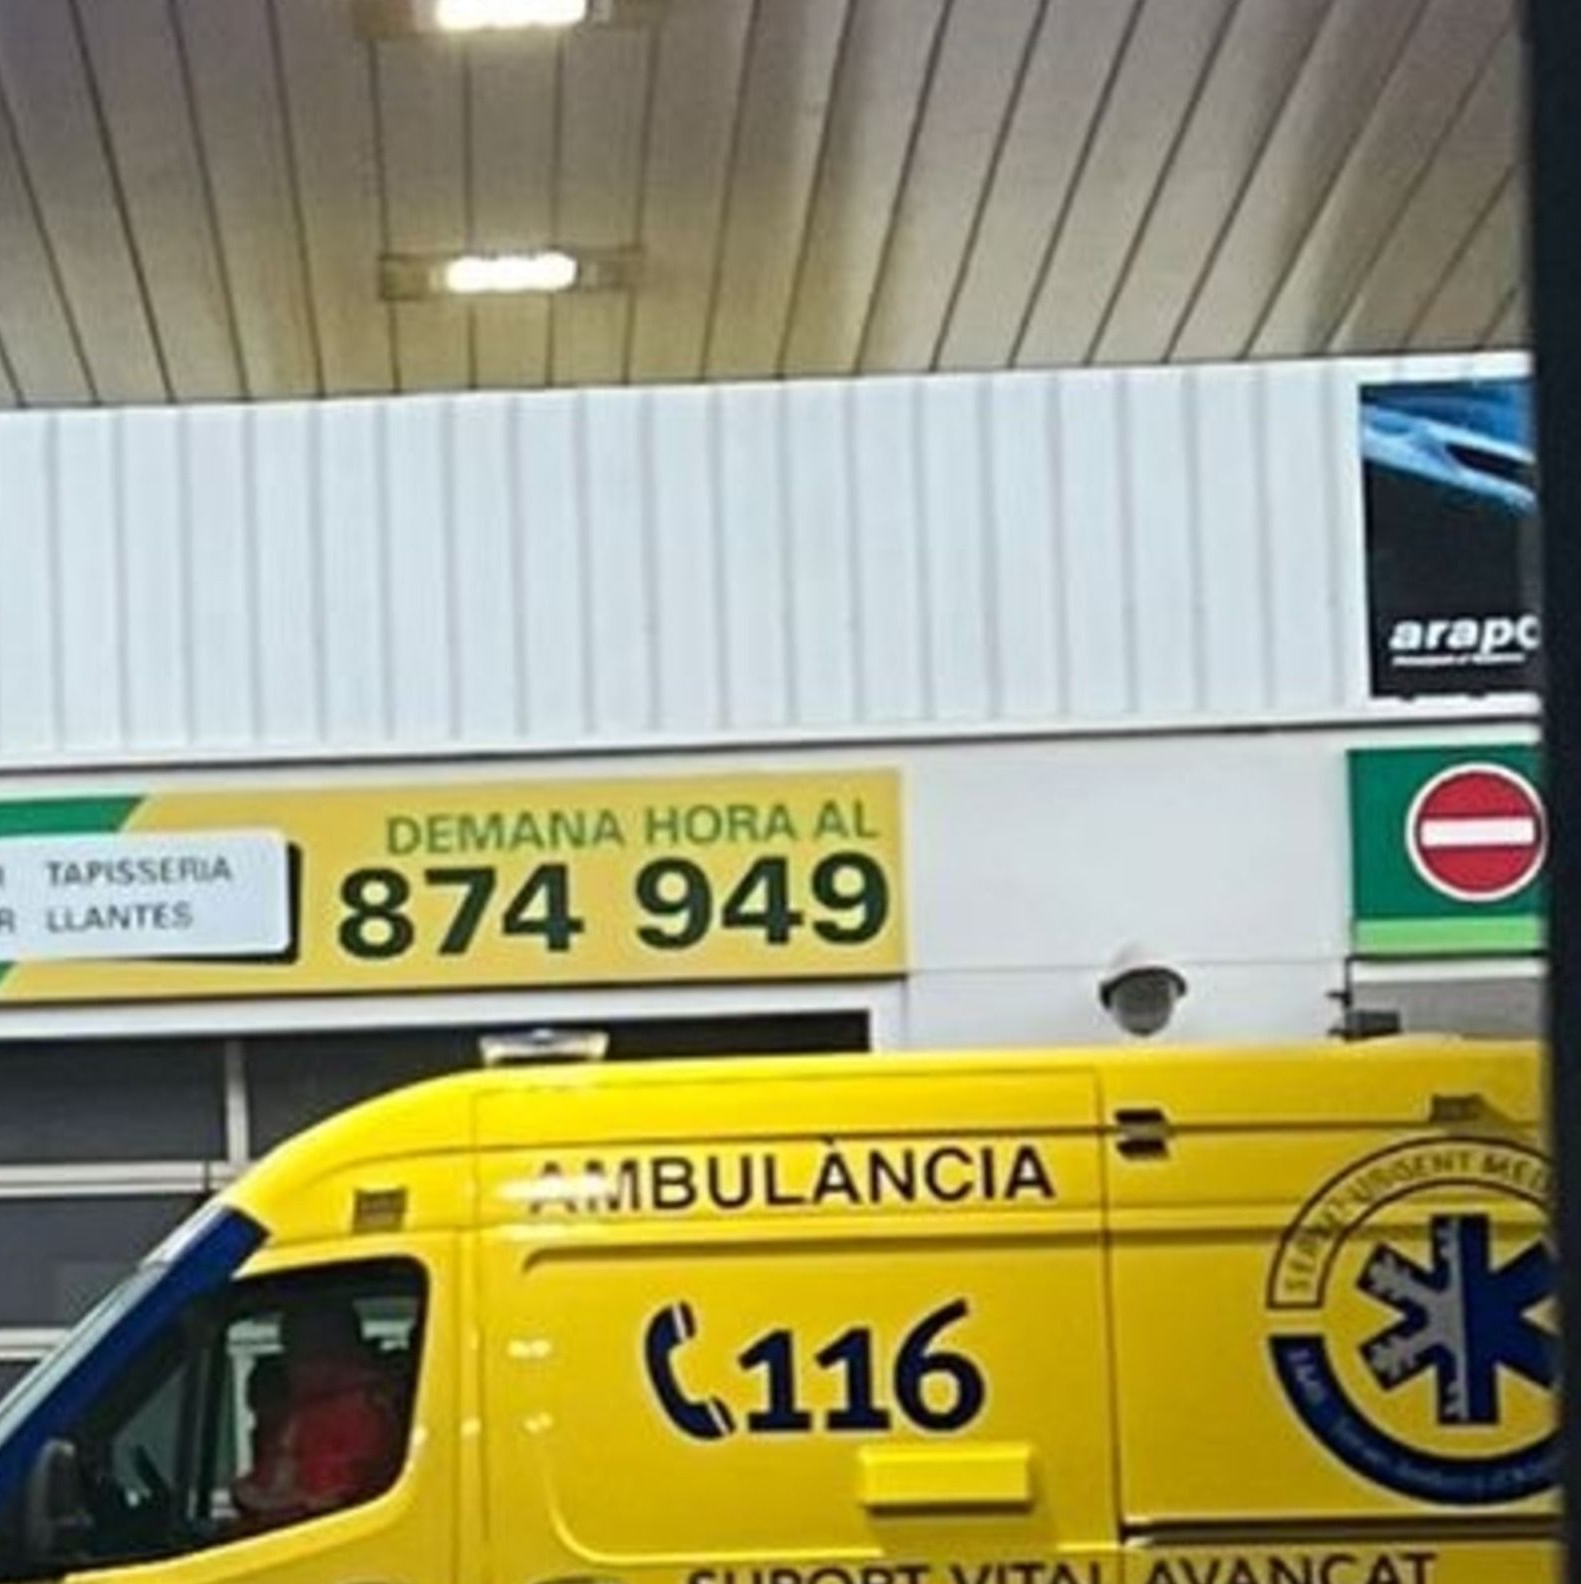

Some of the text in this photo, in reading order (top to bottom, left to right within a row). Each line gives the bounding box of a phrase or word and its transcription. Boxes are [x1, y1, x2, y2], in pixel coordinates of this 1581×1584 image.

[387, 800, 877, 856] DEMANA HORA AL
[45, 856, 231, 886] TAPISSERIA
[45, 902, 192, 933] LLANTES
[338, 852, 889, 961] 874 949
[530, 1136, 1056, 1214] AMBULÀNCIA
[738, 1298, 985, 1433] 116
